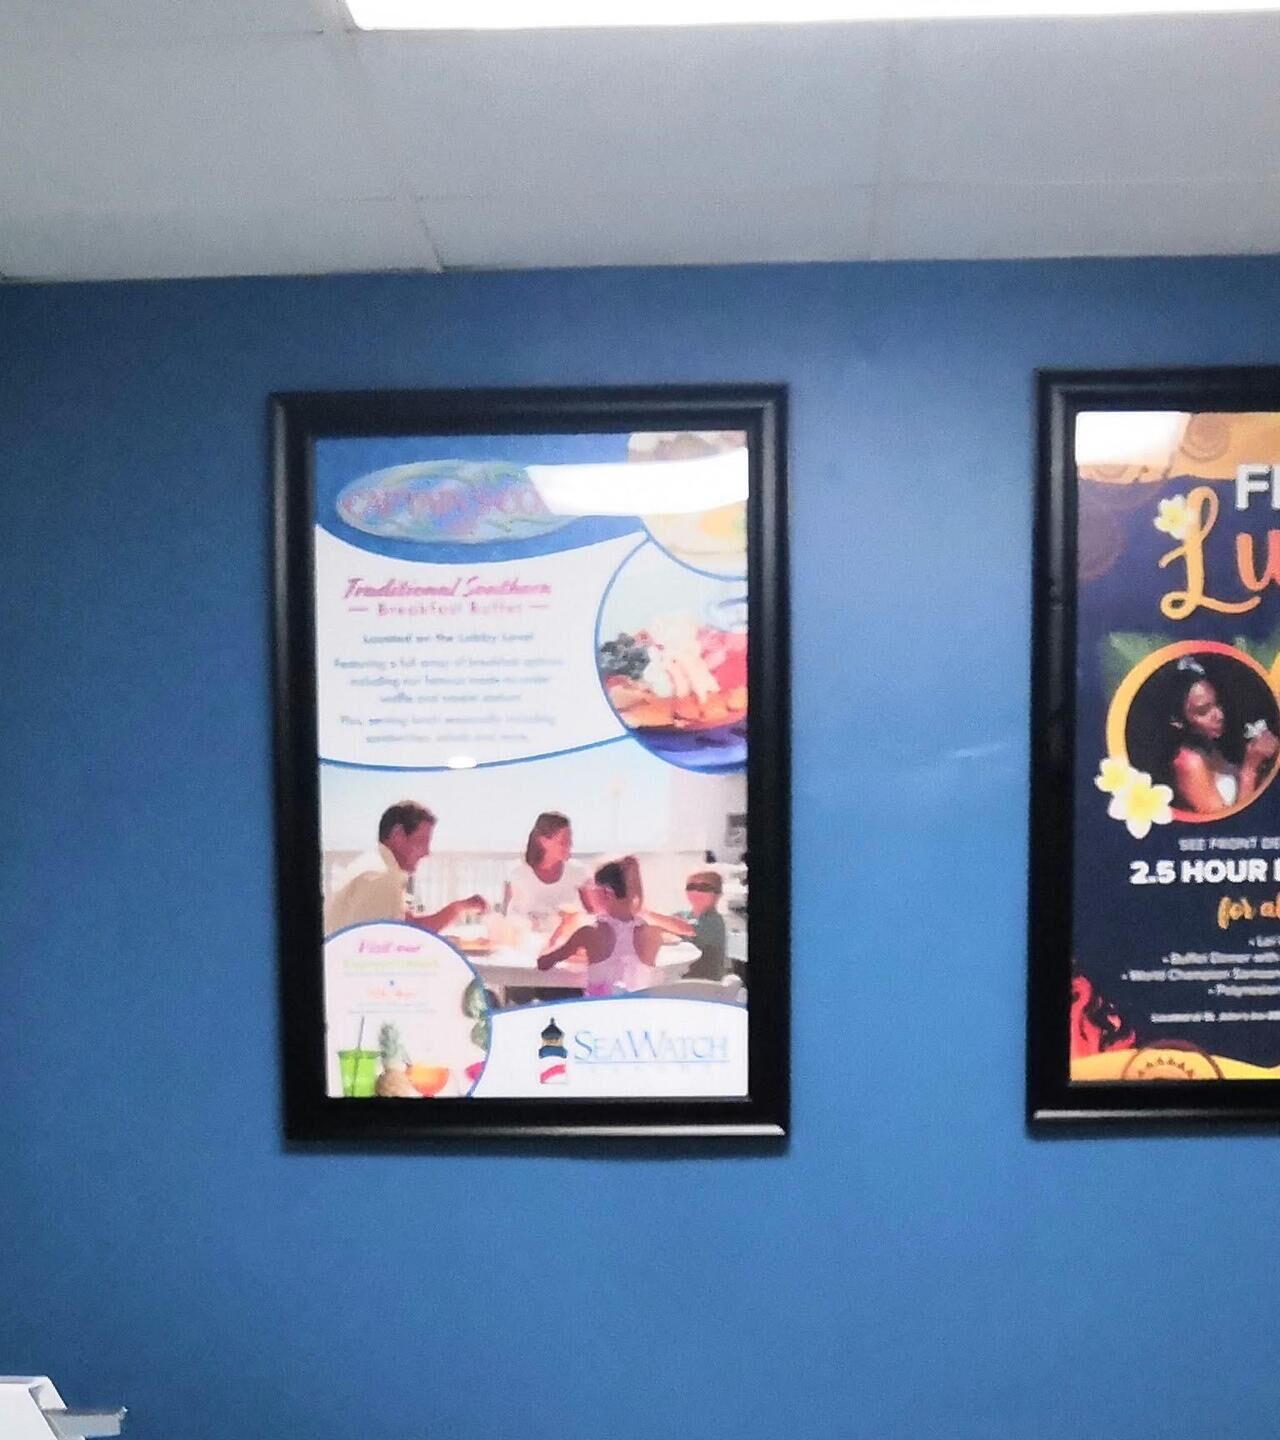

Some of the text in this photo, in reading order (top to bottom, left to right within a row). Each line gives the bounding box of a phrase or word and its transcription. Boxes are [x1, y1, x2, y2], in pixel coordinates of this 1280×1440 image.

[344, 575, 553, 598] Traditional Southern
[378, 602, 462, 616] Breakfast
[1177, 837, 1207, 851] SEE
[1209, 836, 1258, 851] FRONT
[1129, 859, 1176, 885] 2.5
[1180, 857, 1269, 884] HOUR
[1216, 895, 1255, 930] for
